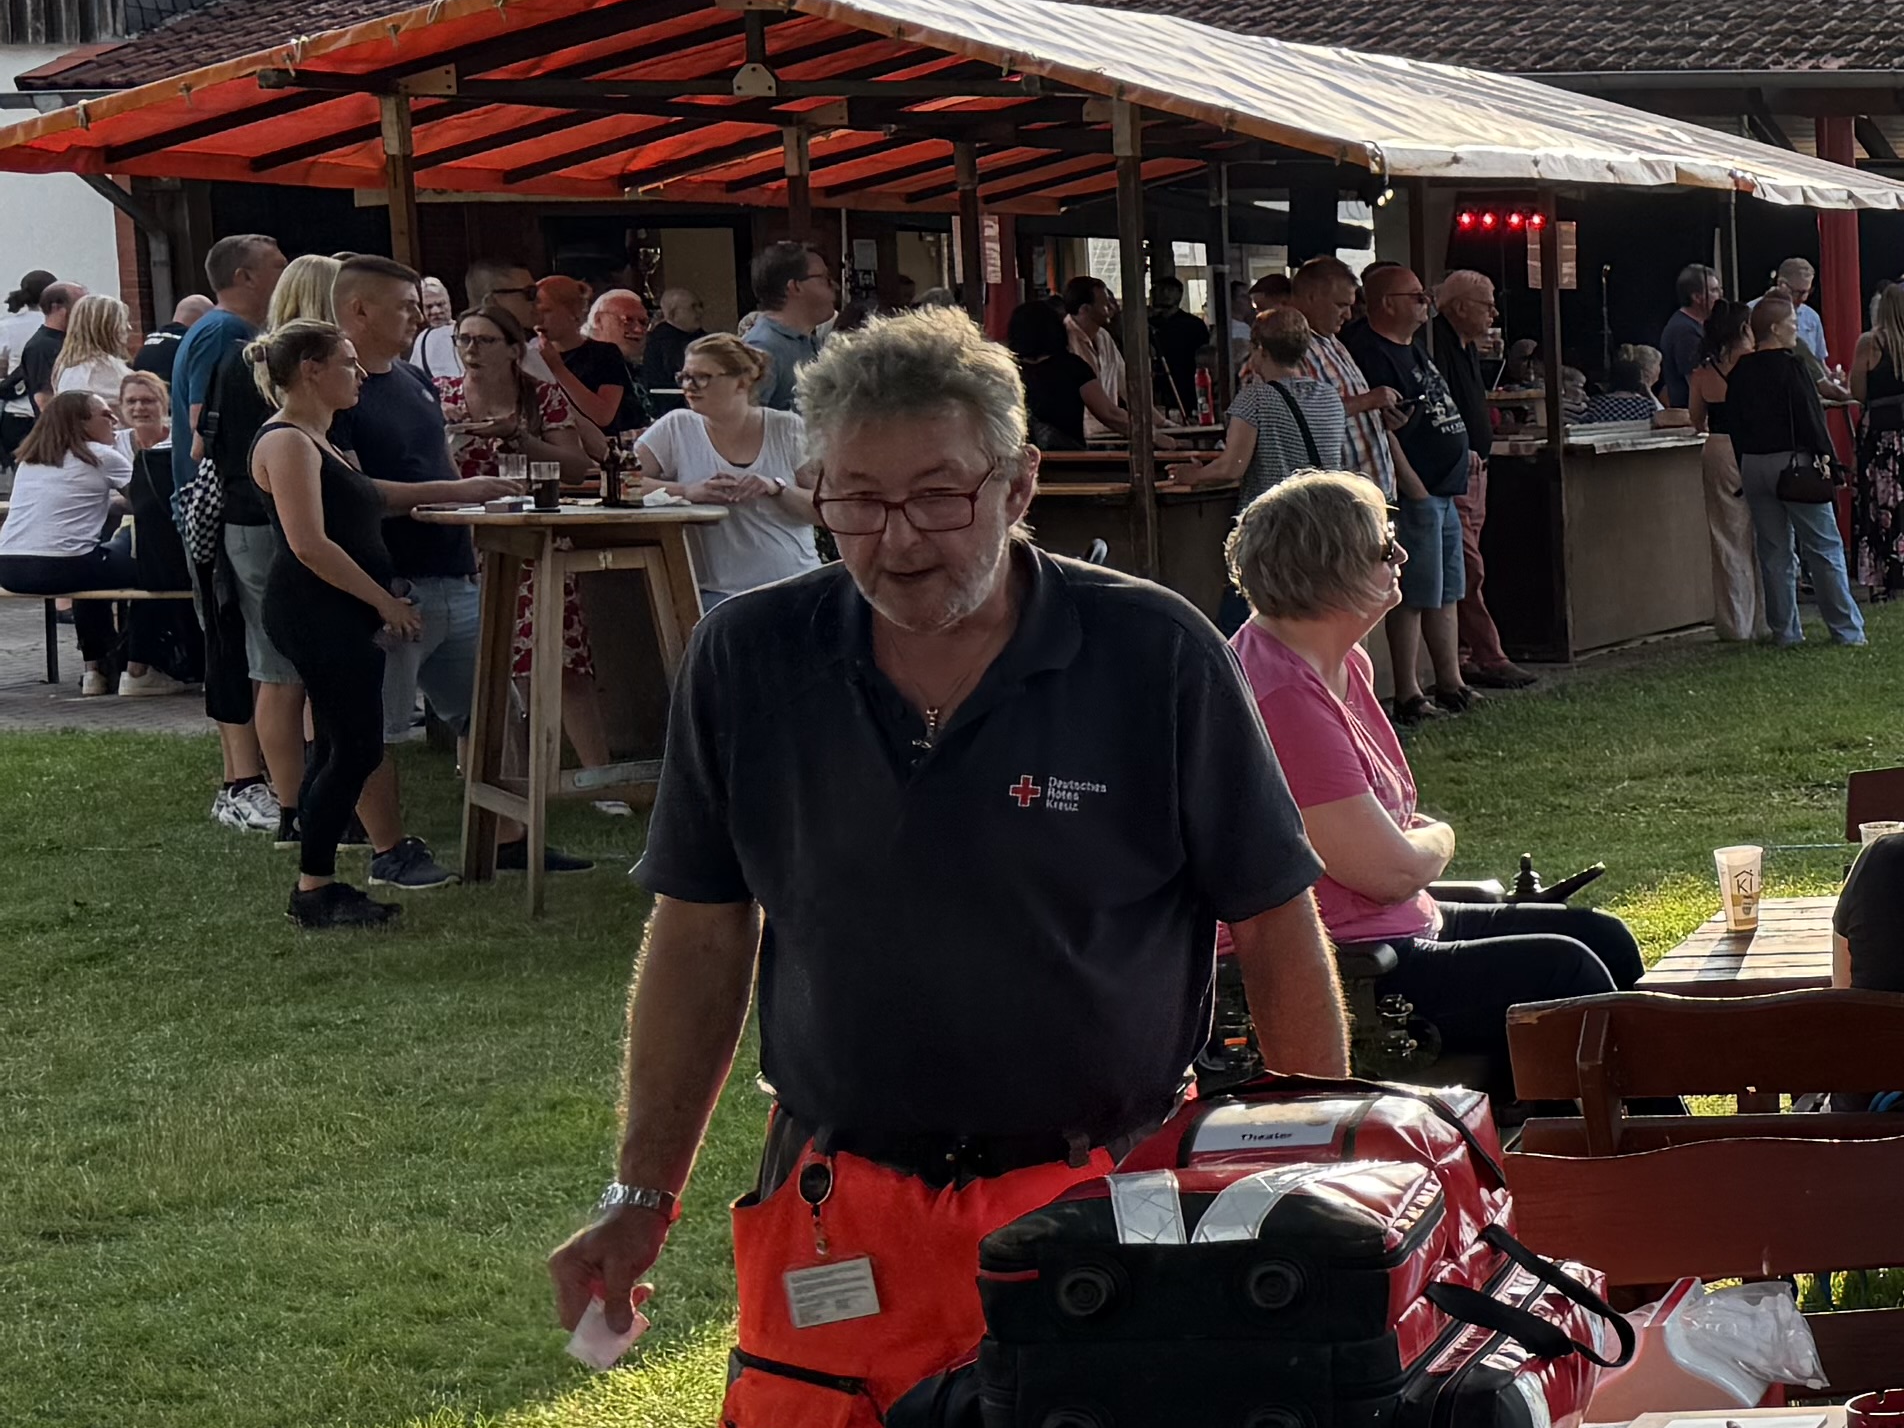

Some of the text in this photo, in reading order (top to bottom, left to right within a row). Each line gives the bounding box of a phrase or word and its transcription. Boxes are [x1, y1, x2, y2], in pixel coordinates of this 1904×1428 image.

[1048, 776, 1107, 793] Deutsches
[1047, 788, 1080, 801] Rotes
[1046, 799, 1079, 812] Kreuz
